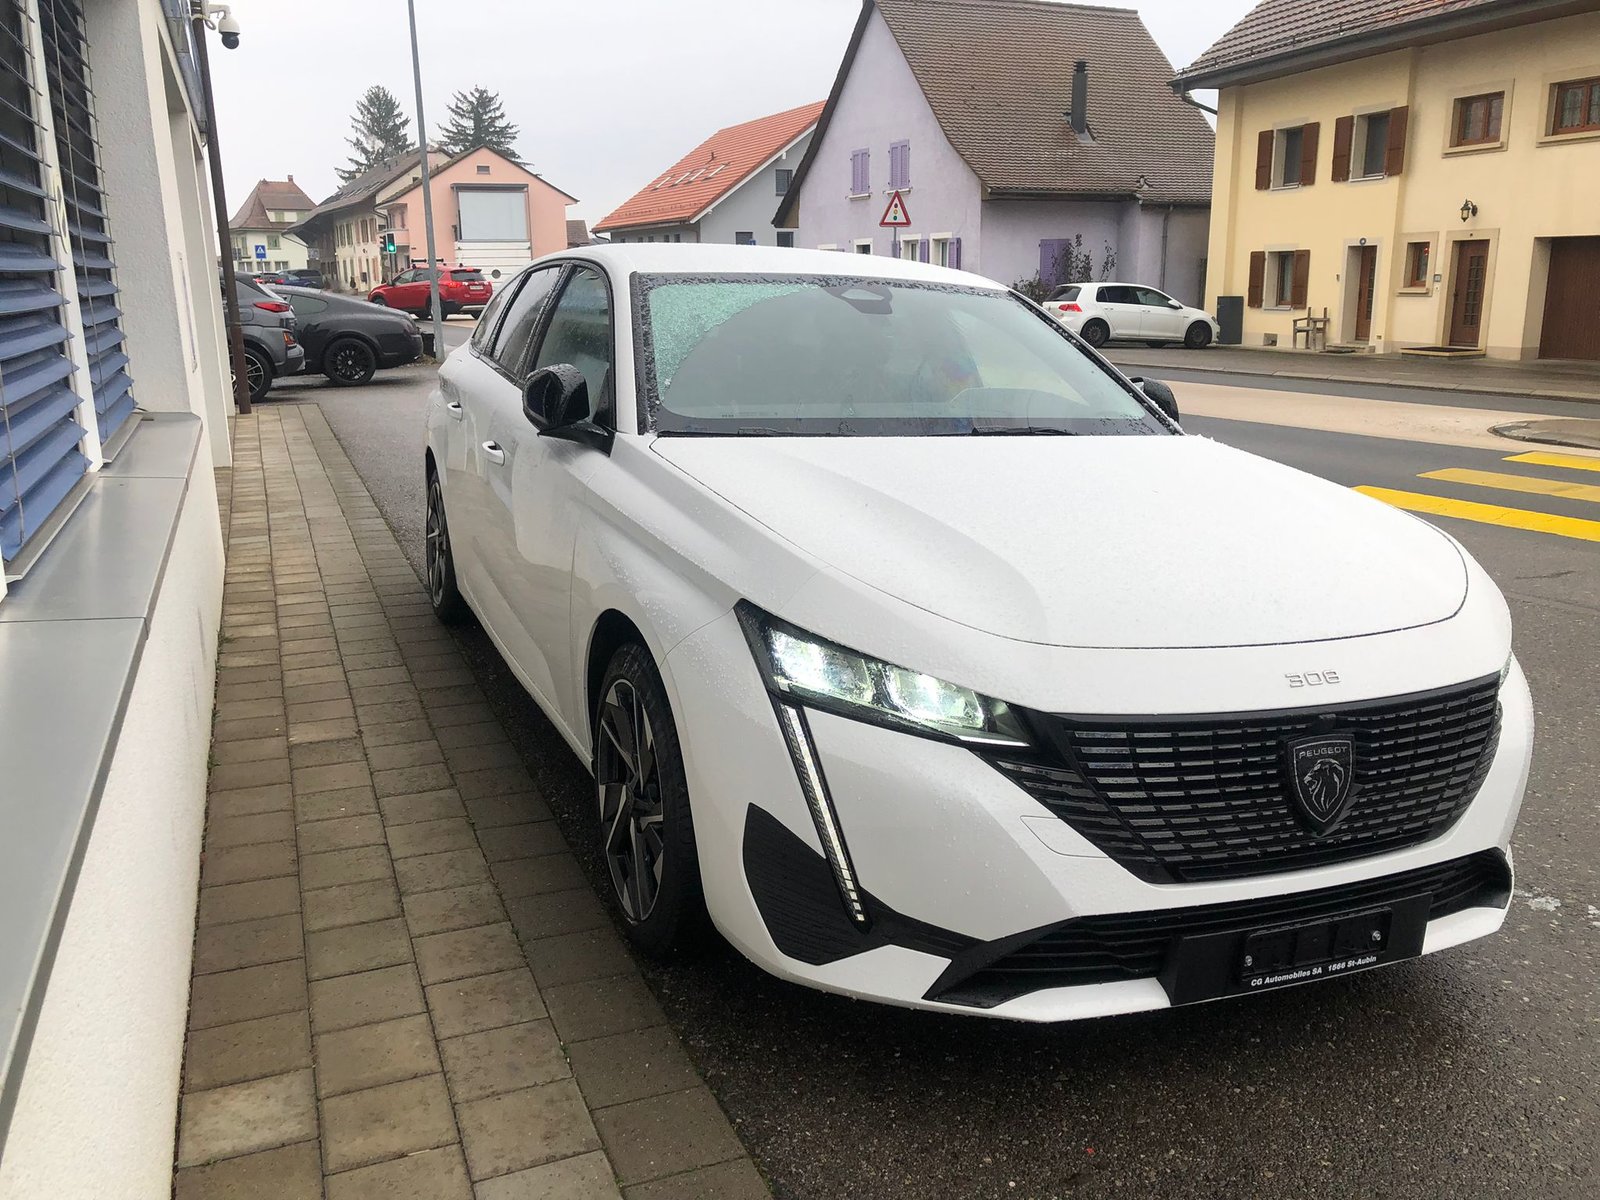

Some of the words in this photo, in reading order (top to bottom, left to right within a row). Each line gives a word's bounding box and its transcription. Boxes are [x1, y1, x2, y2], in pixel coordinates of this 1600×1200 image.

[1285, 670, 1341, 688] 308
[1299, 746, 1348, 759] PEUGEOT
[1251, 978, 1263, 986] CG
[1264, 970, 1311, 984] Automobiles
[1312, 967, 1322, 976] SA
[1347, 956, 1377, 968] St-Aubin
